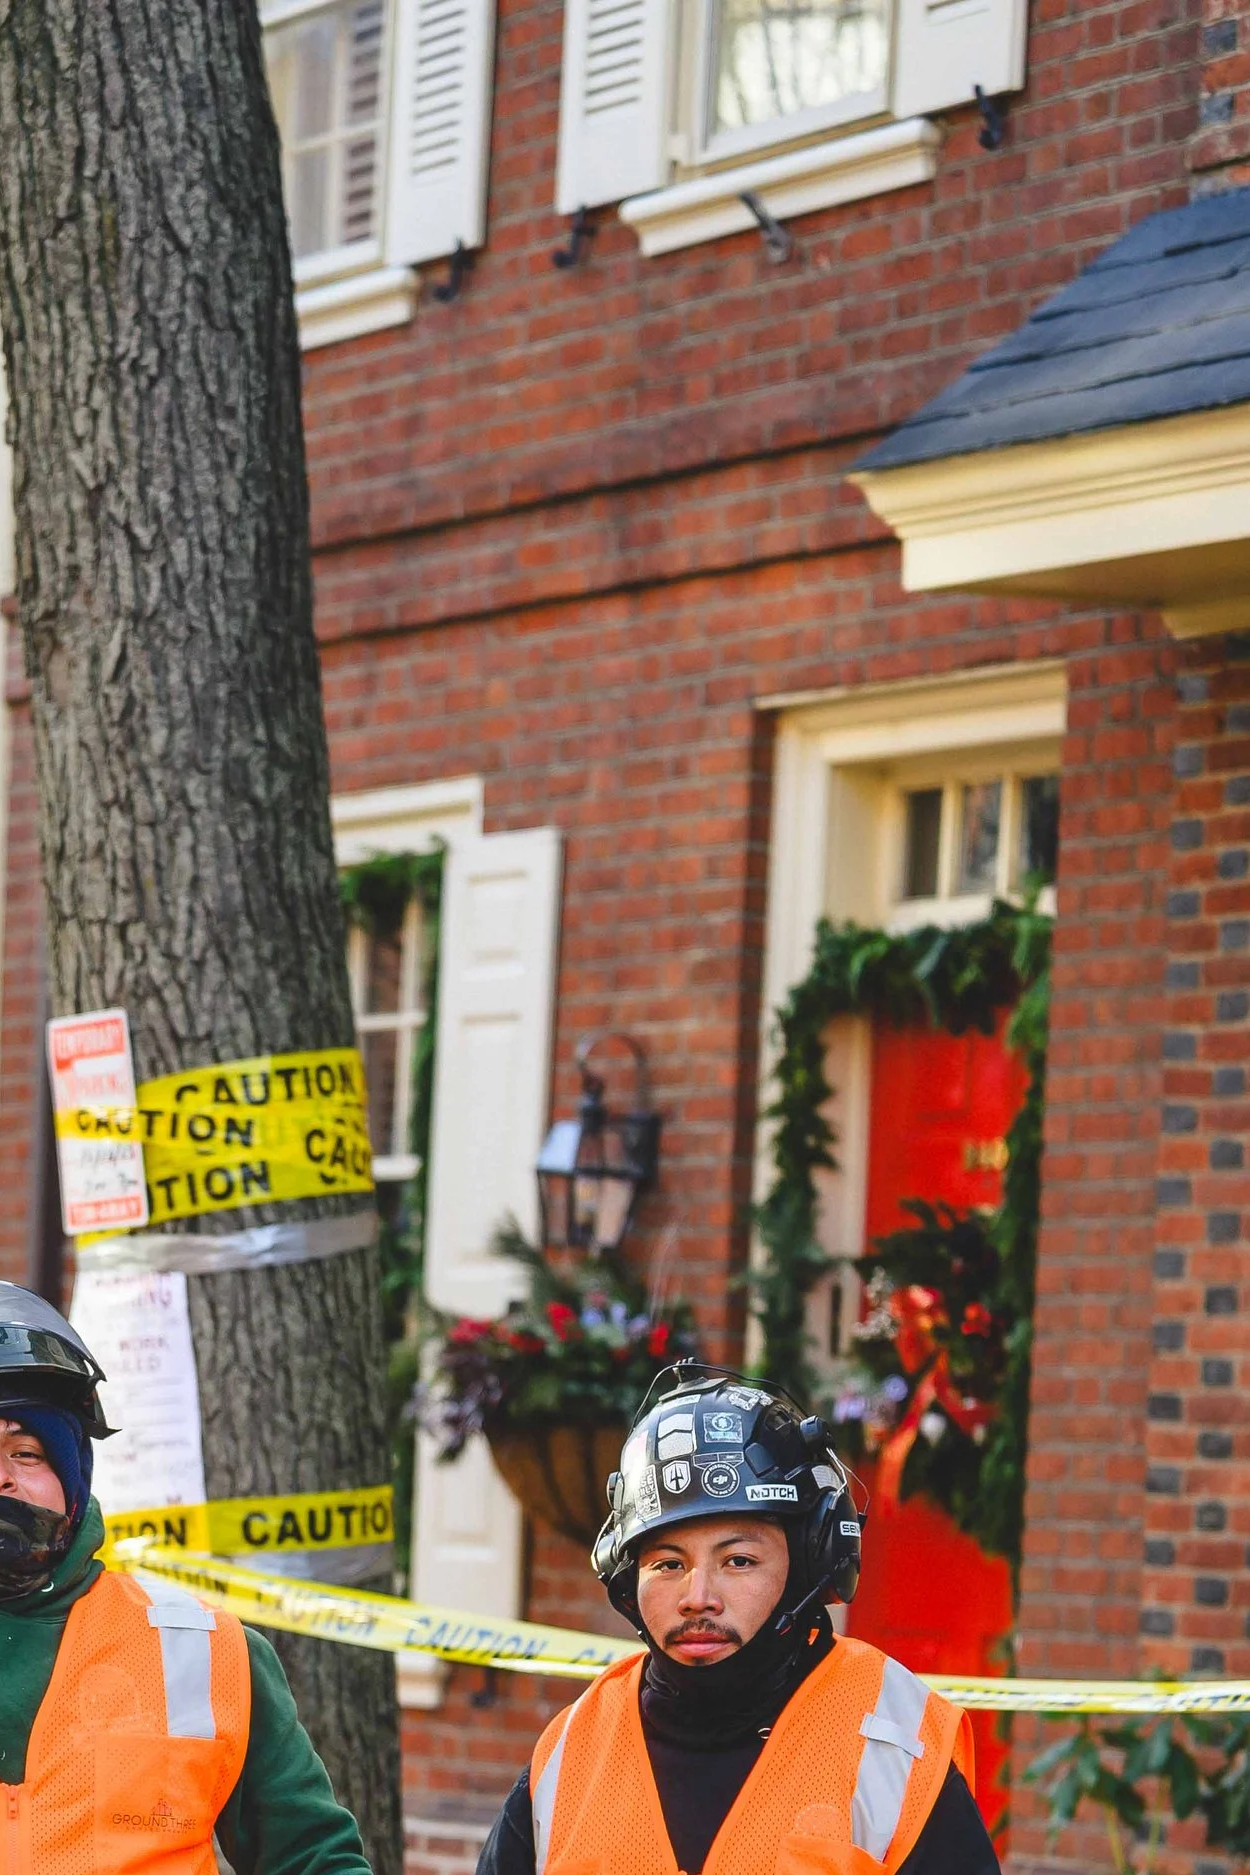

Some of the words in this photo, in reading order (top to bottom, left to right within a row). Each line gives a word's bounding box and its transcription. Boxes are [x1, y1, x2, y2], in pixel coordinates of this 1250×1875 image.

[77, 1108, 254, 1147] CAUTION
[147, 1160, 271, 1219] TION
[750, 1487, 796, 1499] NOTCH
[241, 1502, 389, 1547] CAUTIO
[405, 1617, 547, 1660] CAUTION
[112, 1813, 168, 1828] GROUND
